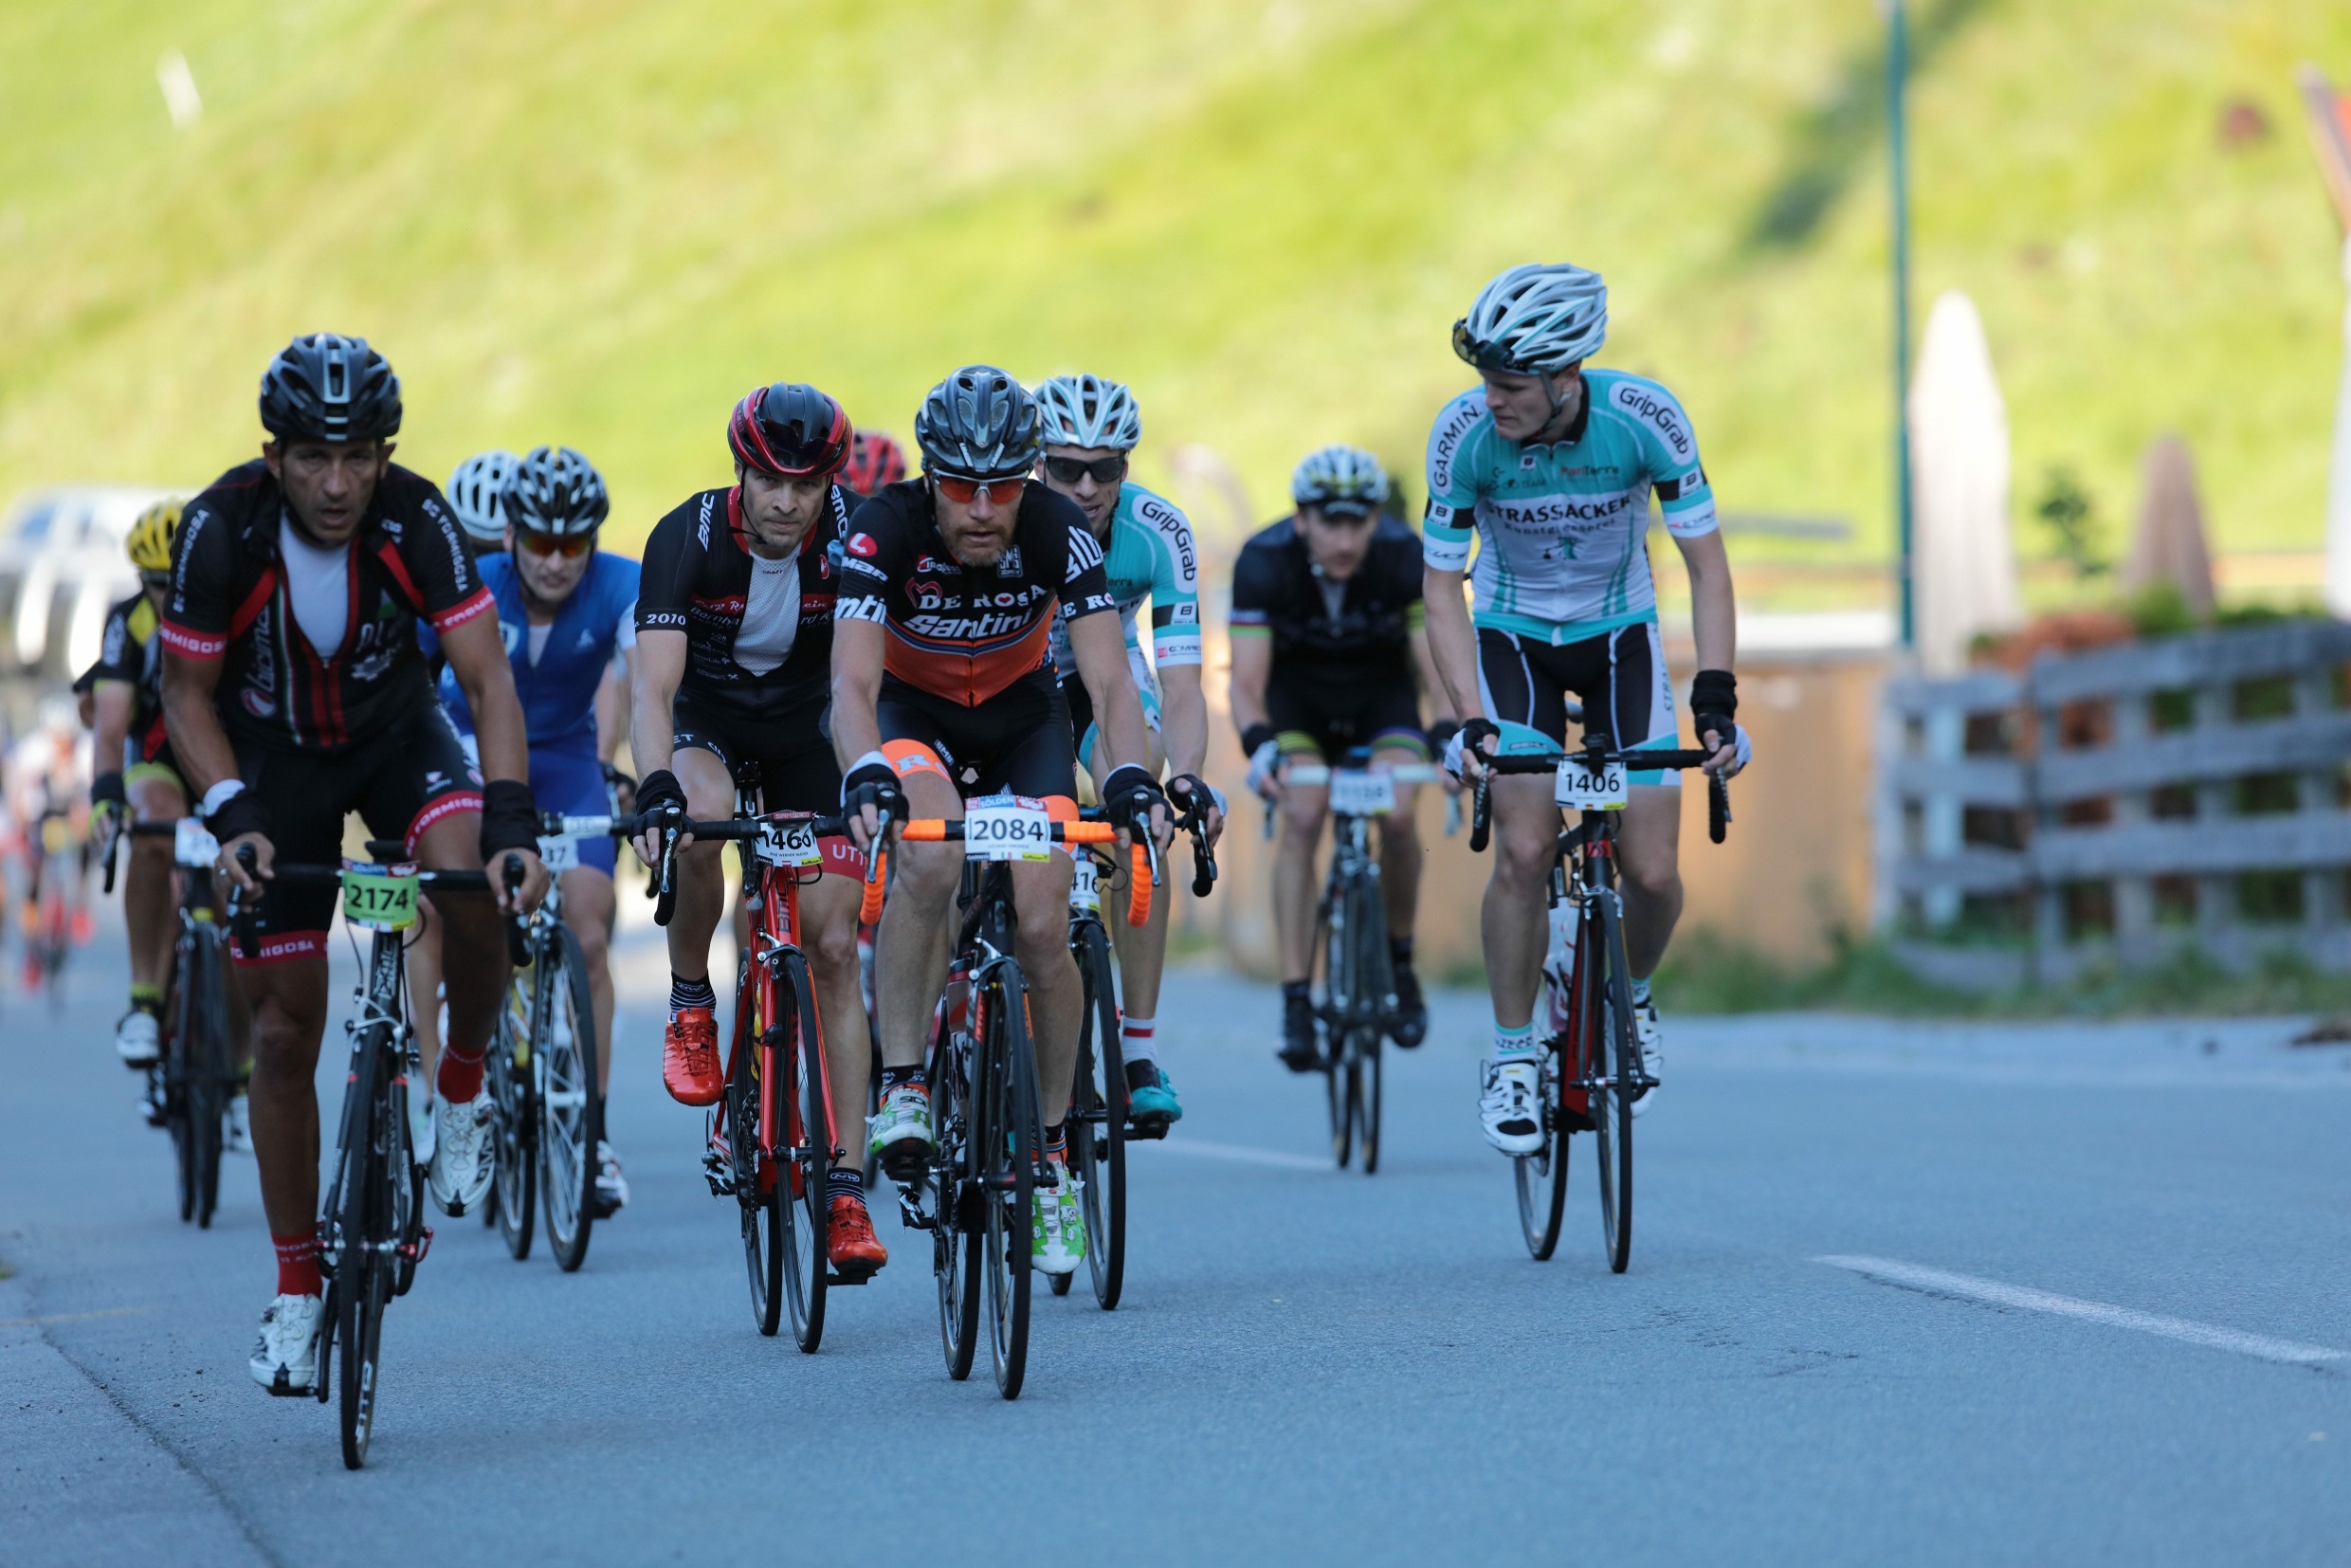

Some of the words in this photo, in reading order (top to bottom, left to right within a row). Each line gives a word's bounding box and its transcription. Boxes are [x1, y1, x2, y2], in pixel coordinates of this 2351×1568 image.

[1618, 387, 1690, 455] GripGrab
[1433, 404, 1483, 488] GARMIN
[698, 492, 714, 553] BMC
[831, 484, 848, 538] BMC
[1141, 501, 1196, 582] GripGrab
[646, 613, 686, 626] 2010
[902, 607, 1032, 638] Santini
[1565, 773, 1620, 793] 1406
[973, 818, 1044, 842] 2084
[350, 883, 409, 911] 2174
